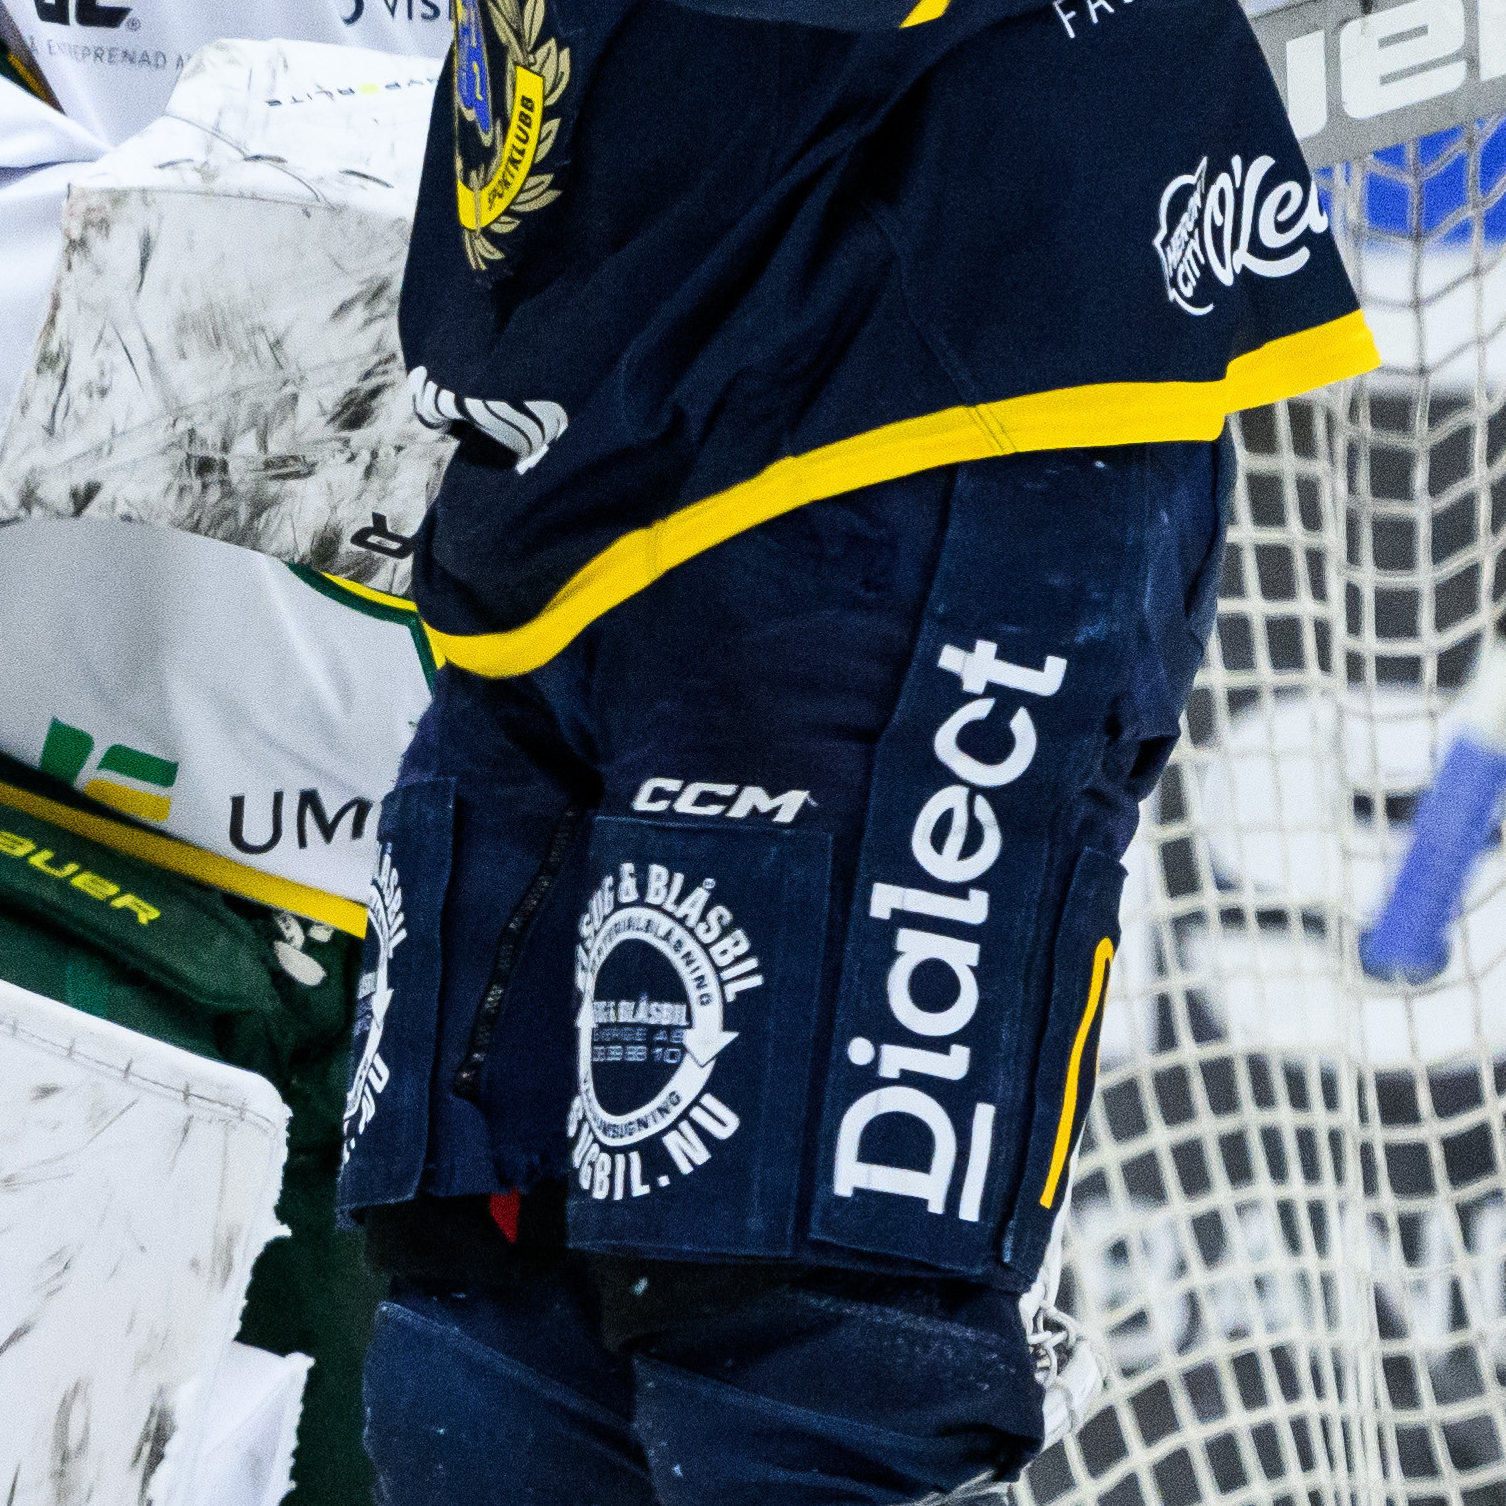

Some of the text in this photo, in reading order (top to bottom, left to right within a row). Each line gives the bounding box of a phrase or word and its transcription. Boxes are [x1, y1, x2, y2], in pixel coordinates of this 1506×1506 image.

[631, 776, 813, 824] CCM
[644, 863, 765, 1004] BLÅSBIL
[833, 638, 1069, 1219] Dialect
